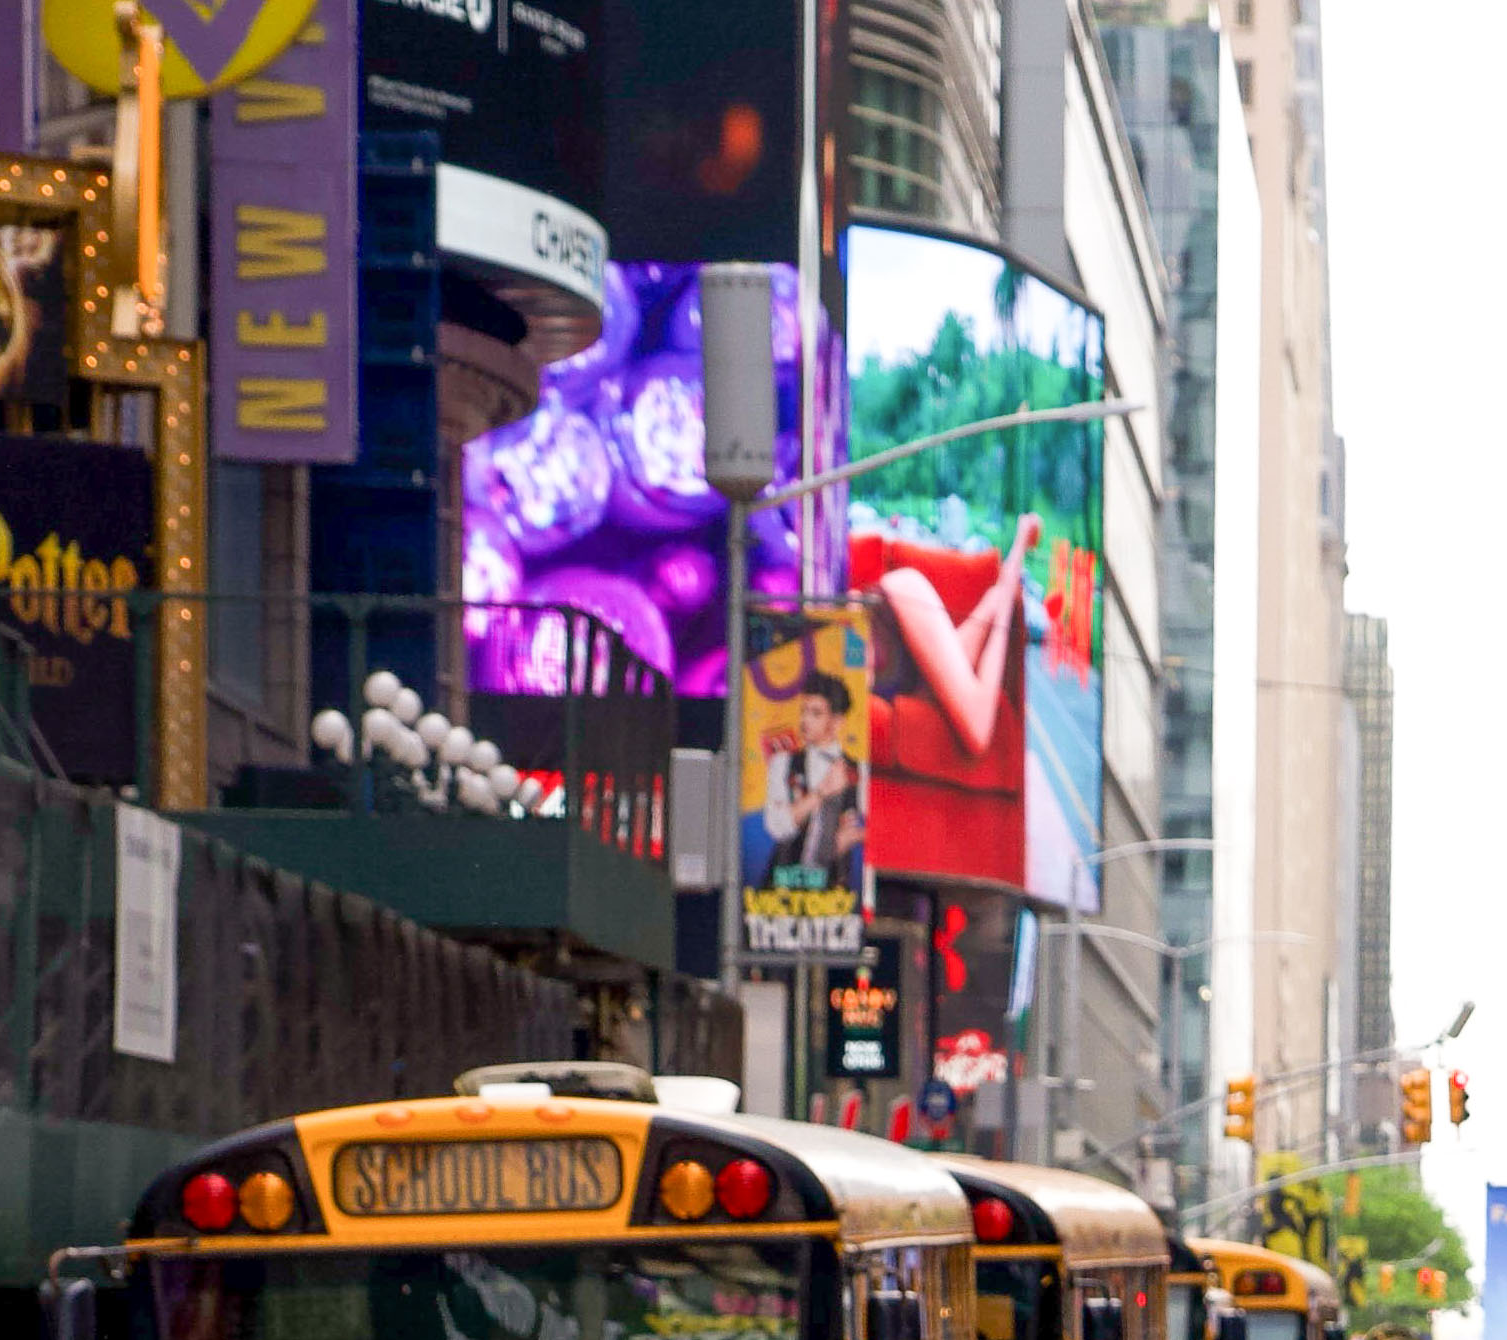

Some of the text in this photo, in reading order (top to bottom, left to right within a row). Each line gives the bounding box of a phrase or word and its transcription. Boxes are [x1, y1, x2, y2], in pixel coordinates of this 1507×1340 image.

[236, 206, 327, 432] NEW
[746, 913, 863, 951] THEATER
[355, 1140, 606, 1210] SCHOOL BUS
